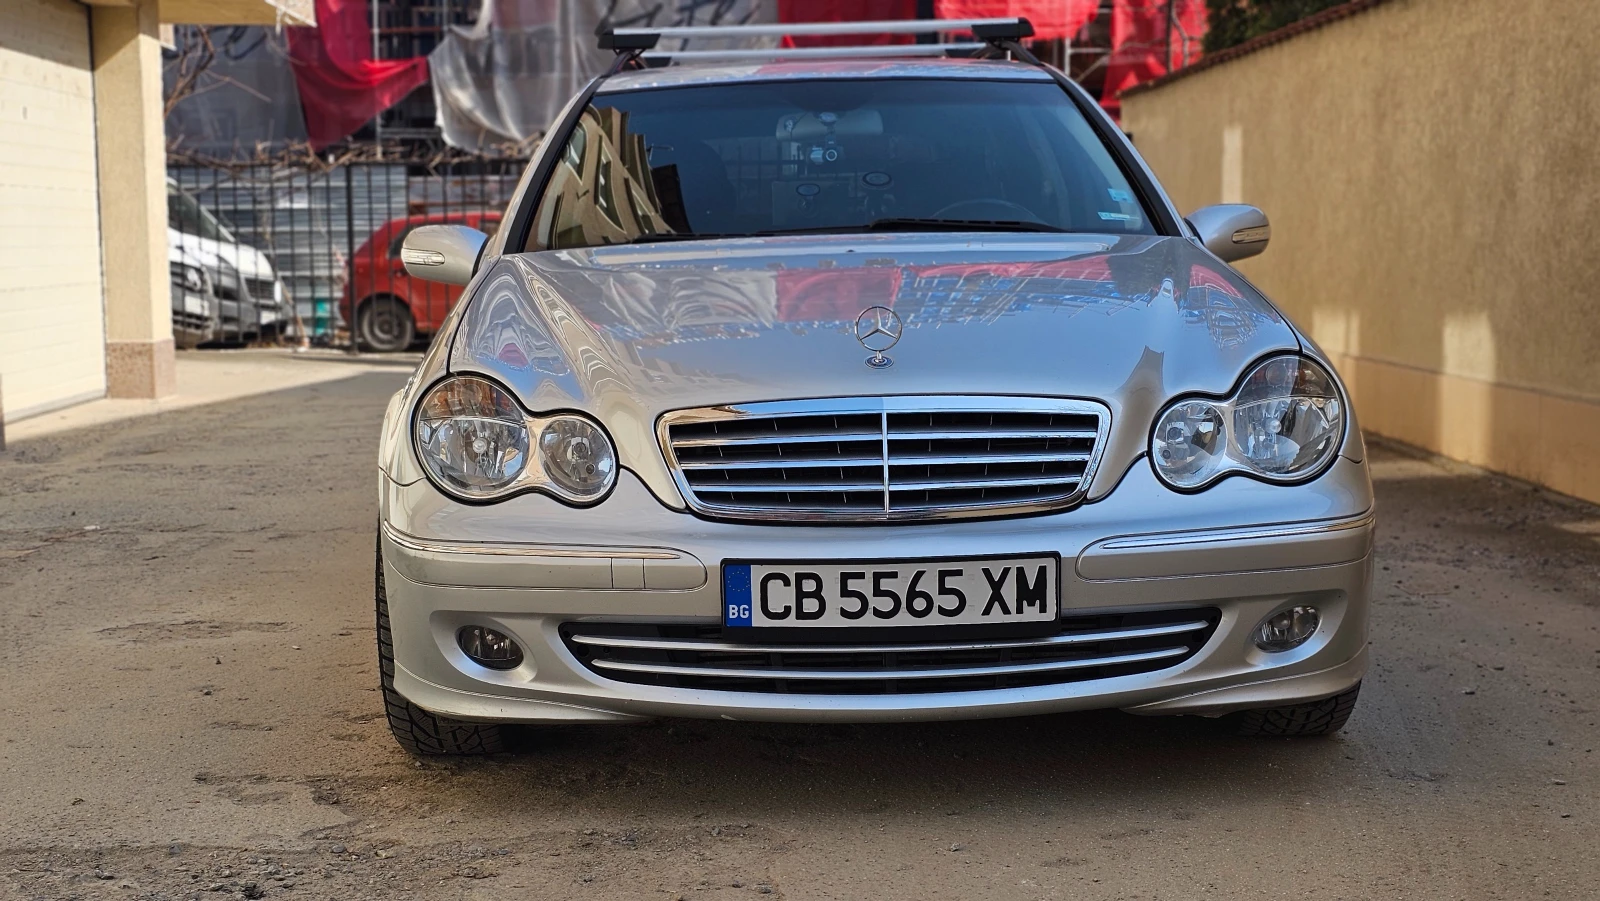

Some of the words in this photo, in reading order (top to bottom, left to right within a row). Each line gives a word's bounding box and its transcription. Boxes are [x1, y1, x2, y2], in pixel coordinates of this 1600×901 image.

[760, 571, 826, 620] CB
[839, 569, 967, 619] 5565
[981, 565, 1047, 615] XM
[728, 604, 750, 619] BG
